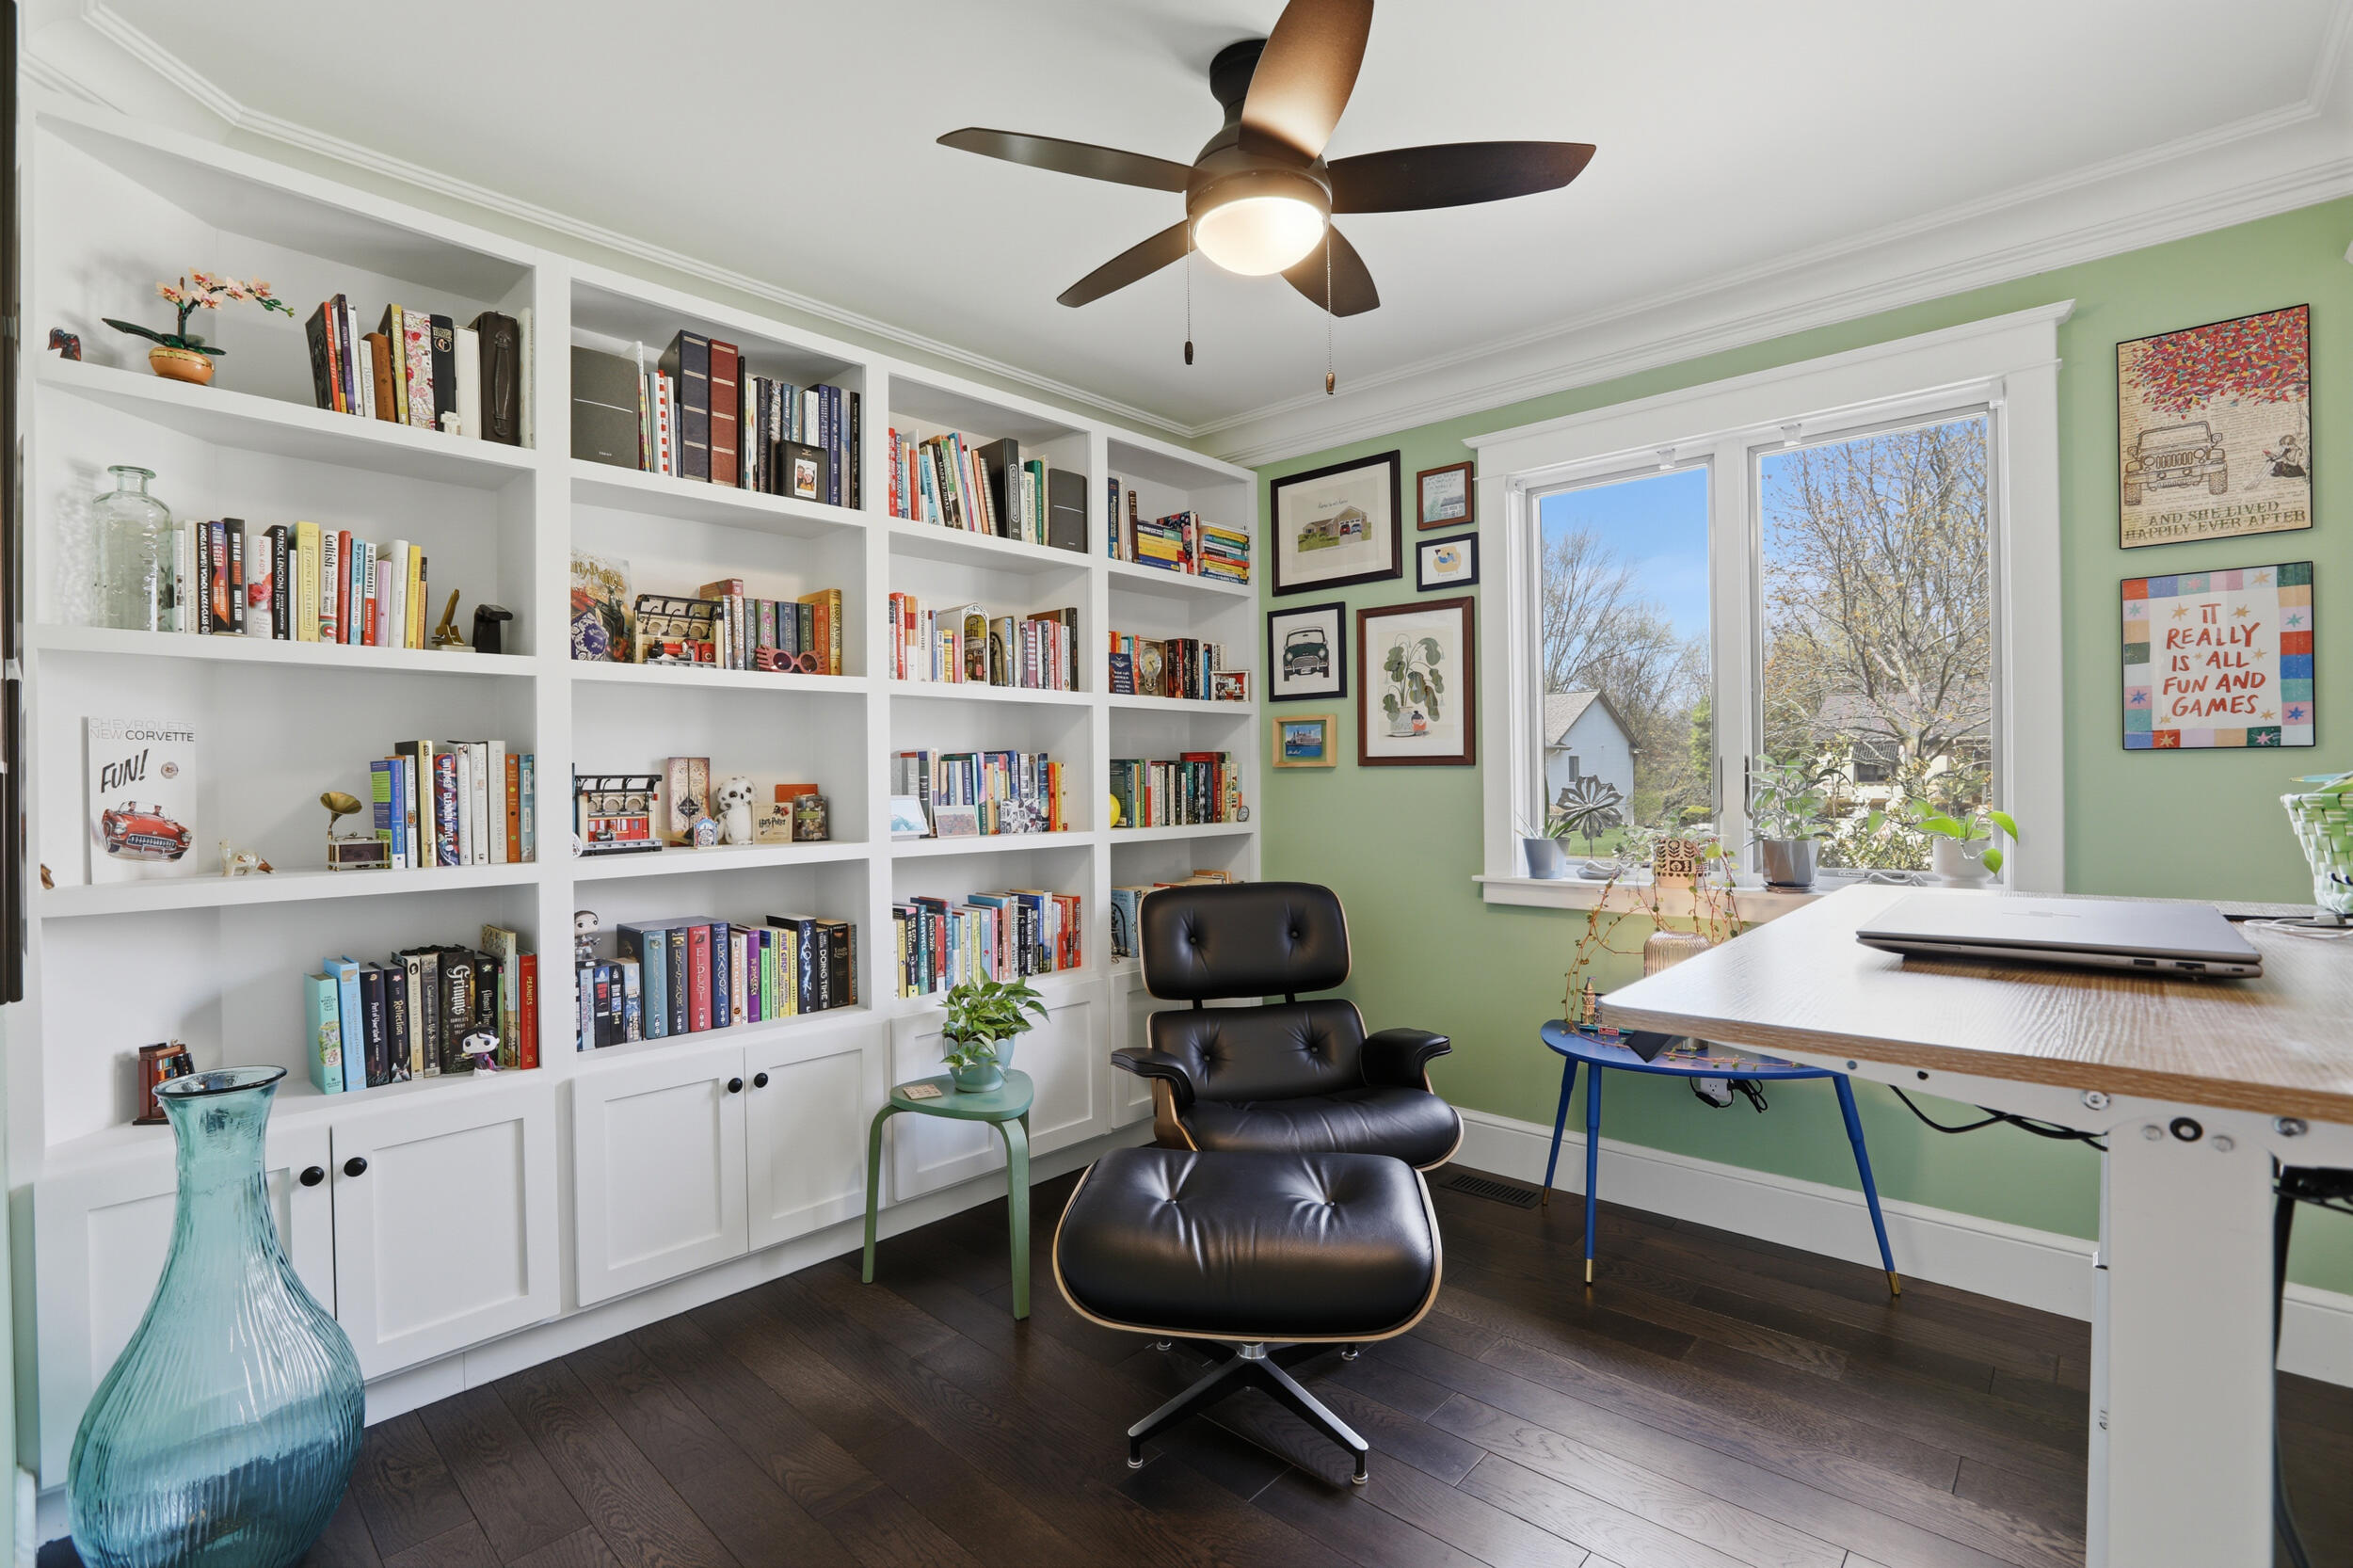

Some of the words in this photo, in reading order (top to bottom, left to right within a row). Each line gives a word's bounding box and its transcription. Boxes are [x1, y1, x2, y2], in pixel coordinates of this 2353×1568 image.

[2125, 523, 2189, 540] HAPPILY
[2198, 518, 2241, 532] EVER
[2245, 510, 2306, 525] AFTER
[2149, 512, 2183, 526] AND
[2188, 508, 2220, 521] SHE
[2227, 502, 2280, 518] LIVED
[212, 526, 223, 544] JOHN
[213, 545, 223, 567] GREEN
[324, 535, 337, 568] Cultish
[2199, 603, 2221, 625] IT
[2167, 622, 2261, 650] REALLY
[2171, 654, 2190, 672] IS
[2205, 650, 2250, 669] ALL
[2163, 675, 2209, 696] FUN
[2215, 670, 2266, 694] AND
[2171, 694, 2259, 717] GAMES
[89, 717, 195, 732] CHEVROLET'S
[89, 728, 123, 740] NEW
[125, 729, 195, 742] CORVETTE
[101, 748, 150, 793] FUN!
[442, 759, 453, 788] UNTAMED
[444, 822, 454, 842] DOYLE
[759, 818, 772, 828] Harry
[771, 816, 787, 827] Potter
[696, 947, 706, 1000] ELDEST
[716, 943, 728, 996] ERAGON
[819, 949, 827, 979] DOING
[446, 964, 471, 1016] Grimm's
[820, 979, 828, 1000] TIME
[371, 1001, 379, 1012] Part
[393, 1000, 404, 1035] Reflection
[426, 1023, 436, 1034] Ugly
